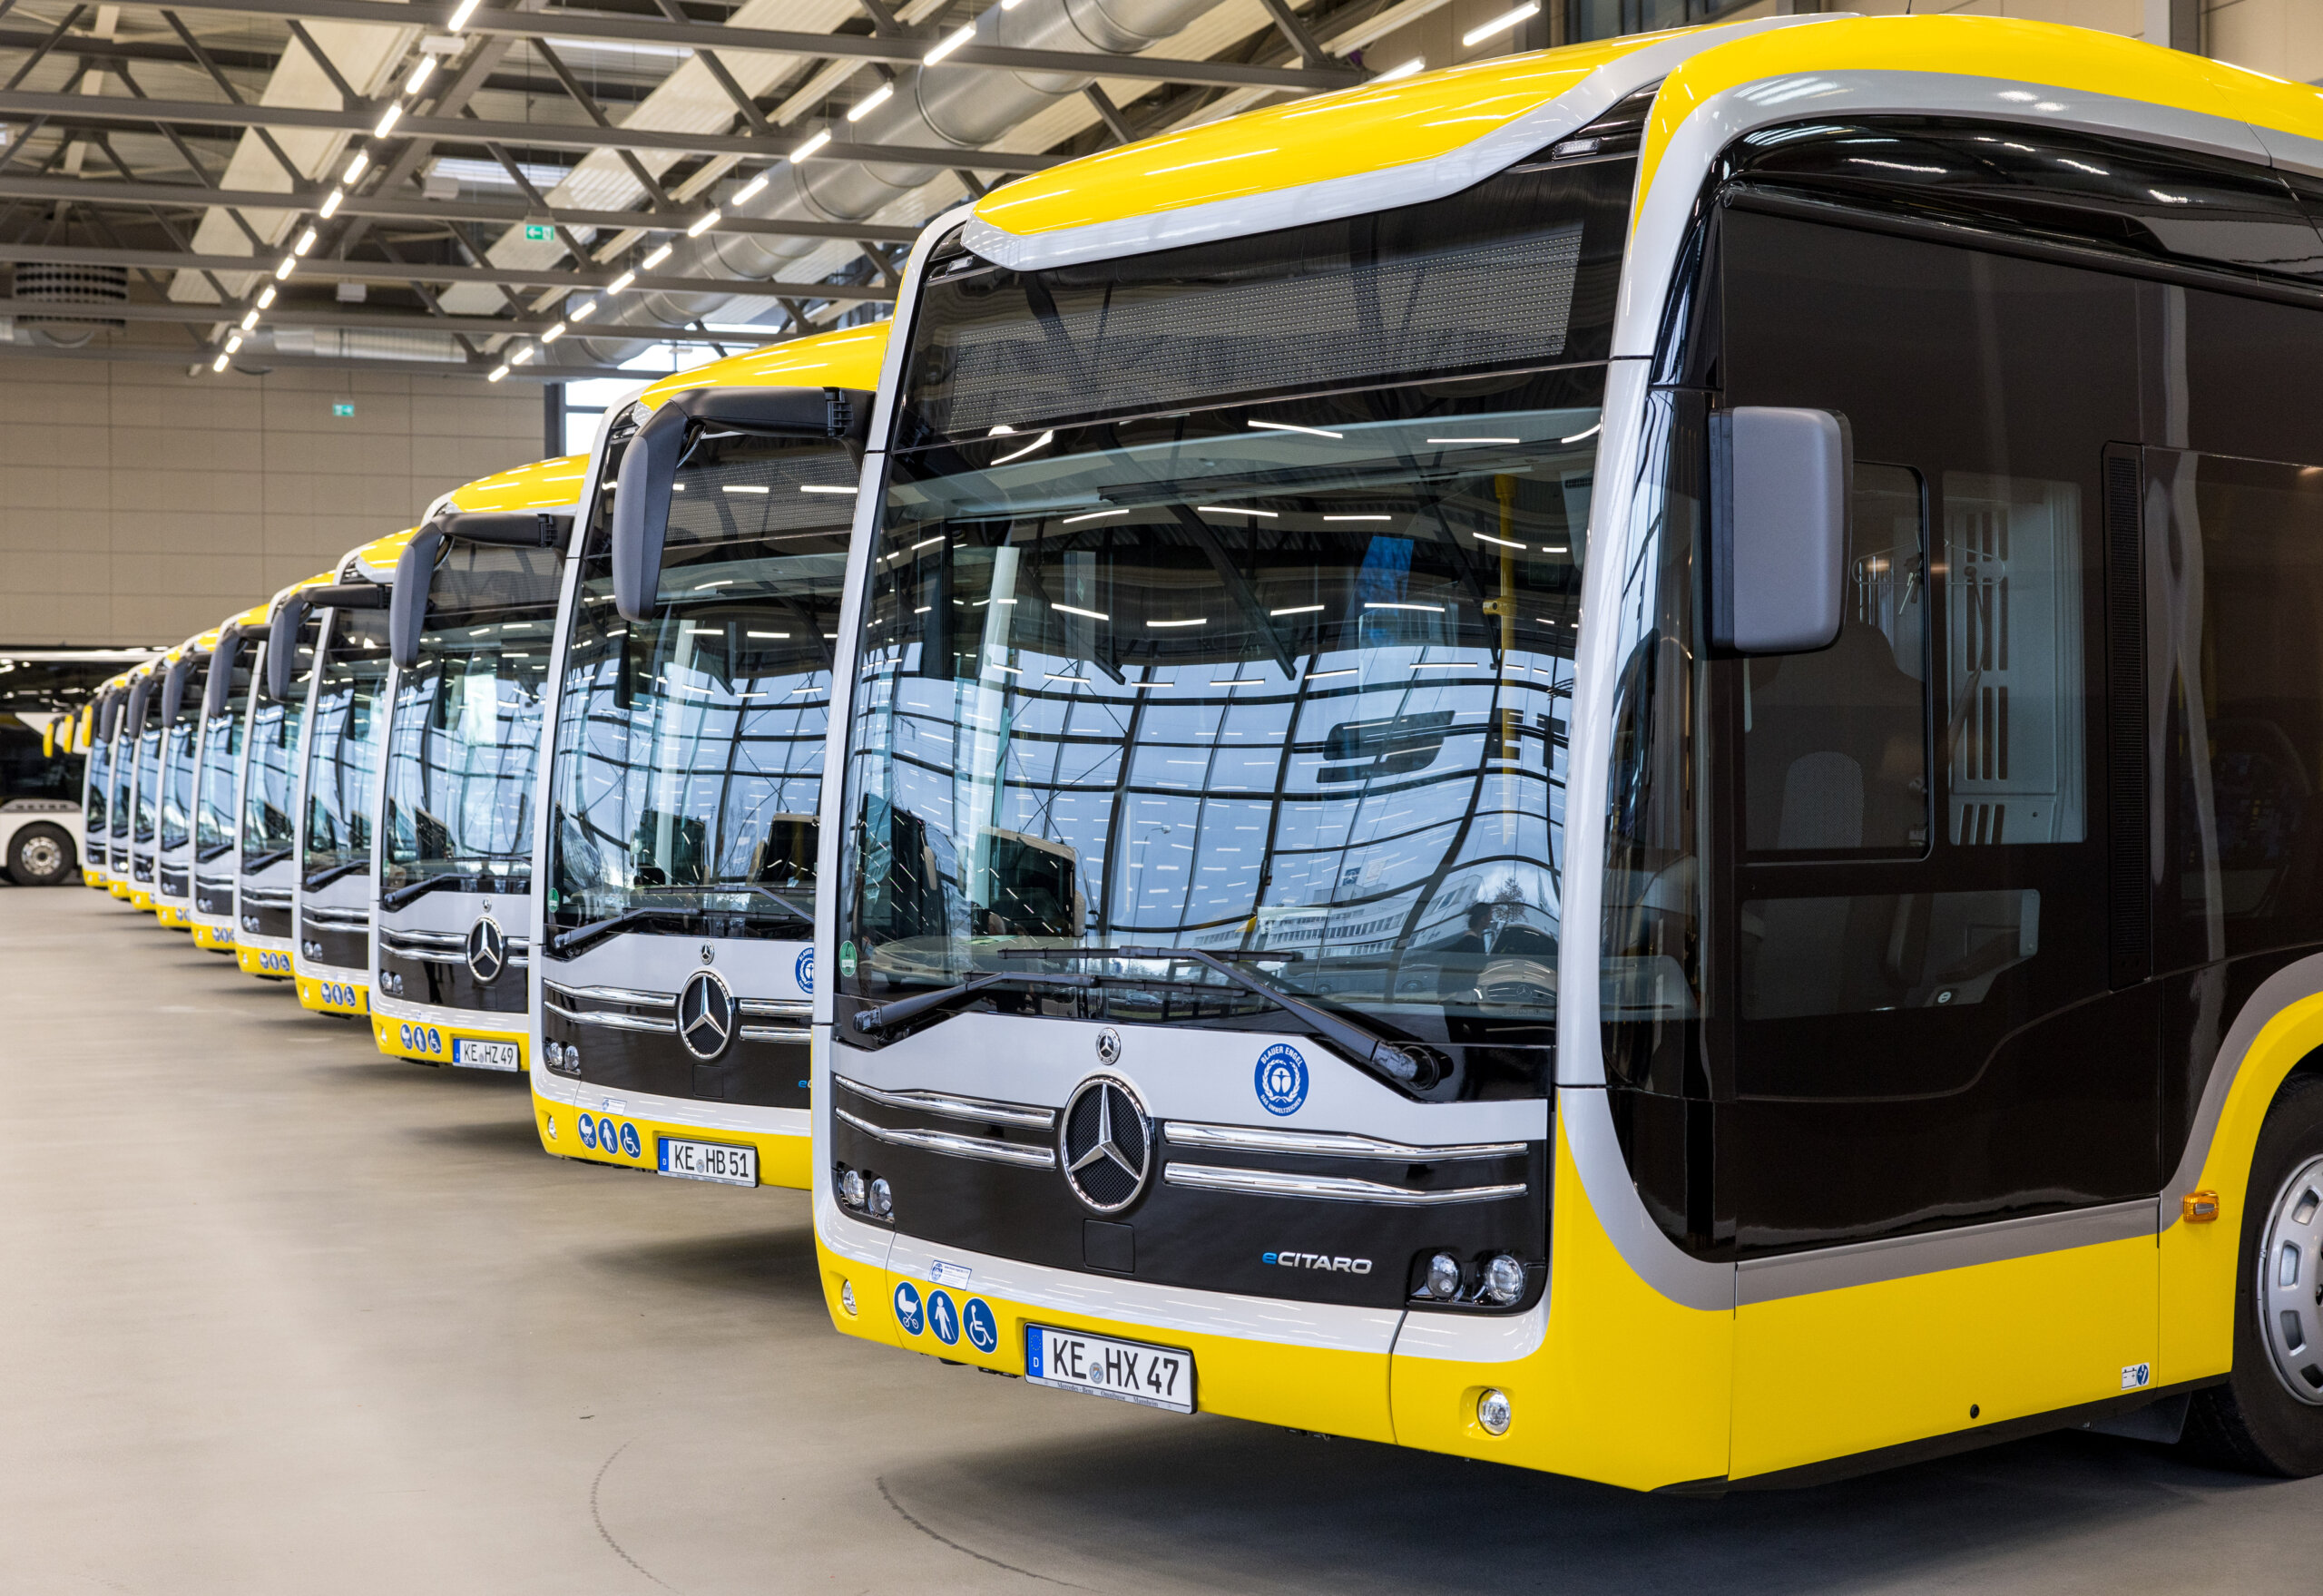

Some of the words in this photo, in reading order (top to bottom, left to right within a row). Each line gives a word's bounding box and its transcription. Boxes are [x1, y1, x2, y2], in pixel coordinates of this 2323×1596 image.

[465, 1043, 477, 1062] KE
[485, 1045, 498, 1063] HZ
[501, 1047, 514, 1065] 49
[1260, 1046, 1284, 1064] BLAUER
[1285, 1047, 1303, 1067] ENGEL
[662, 1158, 667, 1166] D
[674, 1144, 695, 1170] KE
[706, 1149, 726, 1174] HB
[730, 1151, 749, 1178] 51
[1262, 1251, 1372, 1274] eCITARO
[1033, 1356, 1039, 1367] D
[1054, 1337, 1086, 1379] KE
[1105, 1347, 1140, 1390] HX
[1147, 1356, 1179, 1396] 47
